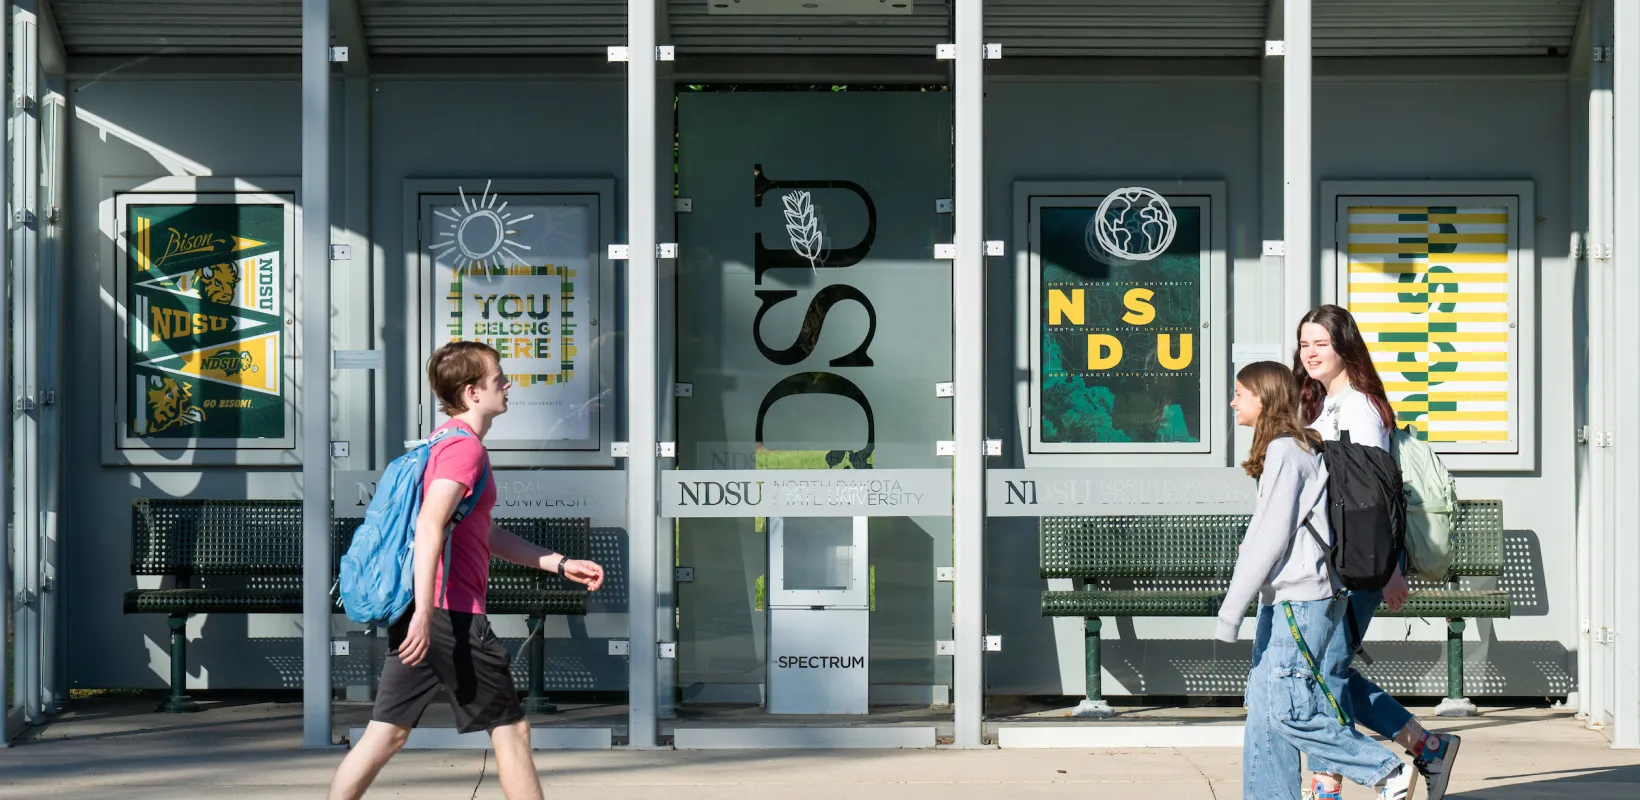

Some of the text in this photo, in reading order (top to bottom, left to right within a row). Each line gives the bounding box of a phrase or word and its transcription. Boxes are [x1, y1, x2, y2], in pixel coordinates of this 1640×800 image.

[154, 227, 225, 267] Bison
[260, 258, 273, 310] NDSU
[472, 293, 551, 320] YOU
[151, 306, 229, 342] NDSU
[474, 321, 551, 335] BELONG
[200, 358, 241, 370] NDSU
[753, 163, 877, 611] DSU
[203, 399, 252, 408] GO BISON!
[678, 481, 764, 506] NDSU
[773, 480, 903, 492] NORTH DAKOTA
[828, 492, 925, 505] UNIVERSITY
[778, 656, 864, 668] SPECTRUM
